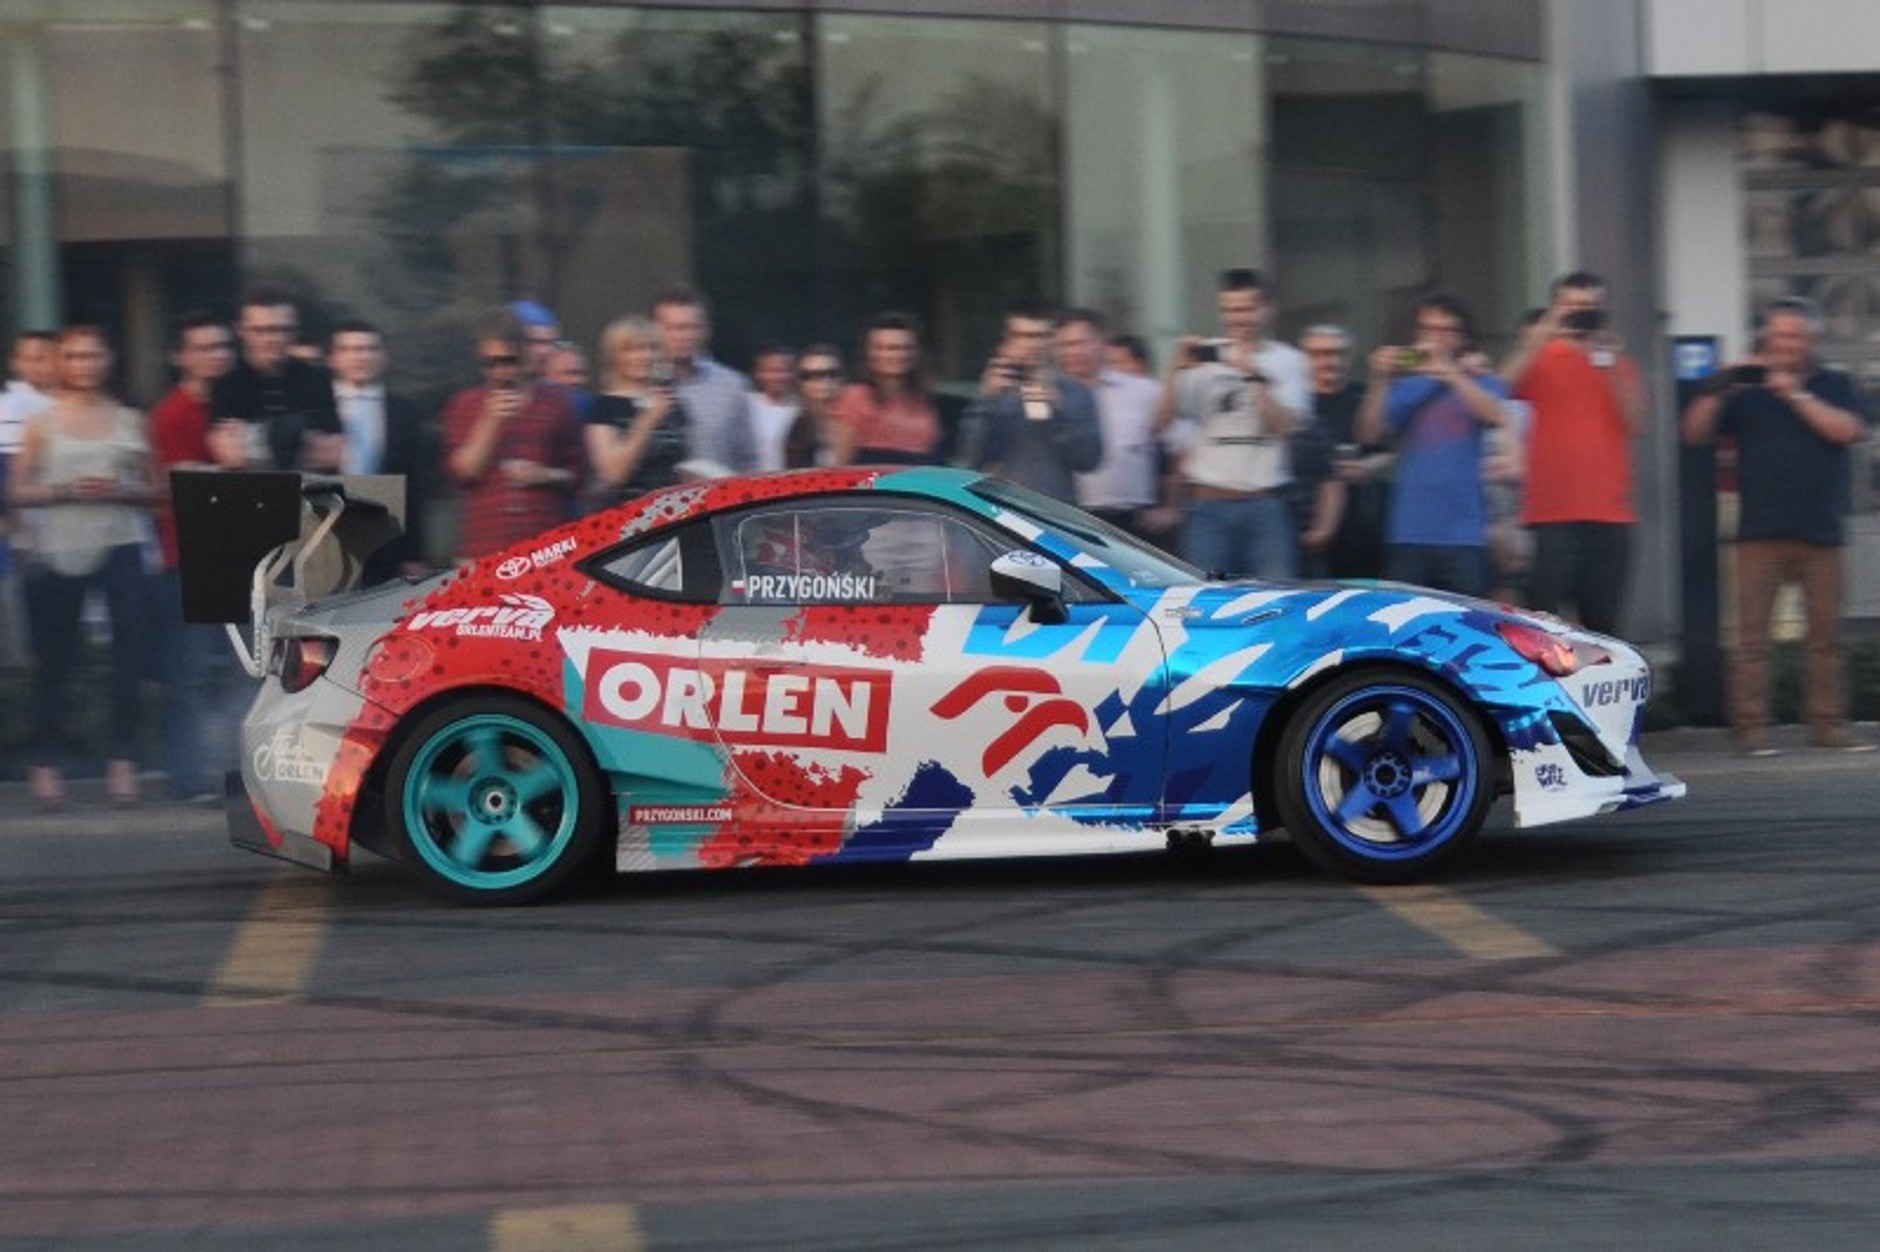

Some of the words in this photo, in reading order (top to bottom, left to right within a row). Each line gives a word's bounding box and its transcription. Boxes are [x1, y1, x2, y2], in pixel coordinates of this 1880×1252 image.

[749, 570, 876, 600] PRZYGOŃSKI
[407, 603, 556, 631] verva
[456, 624, 543, 642] ORLENTEAM.PL
[599, 661, 872, 739] ORLEN
[1583, 677, 1649, 708] verva
[635, 807, 732, 821] PRZYGONSKI.COM
